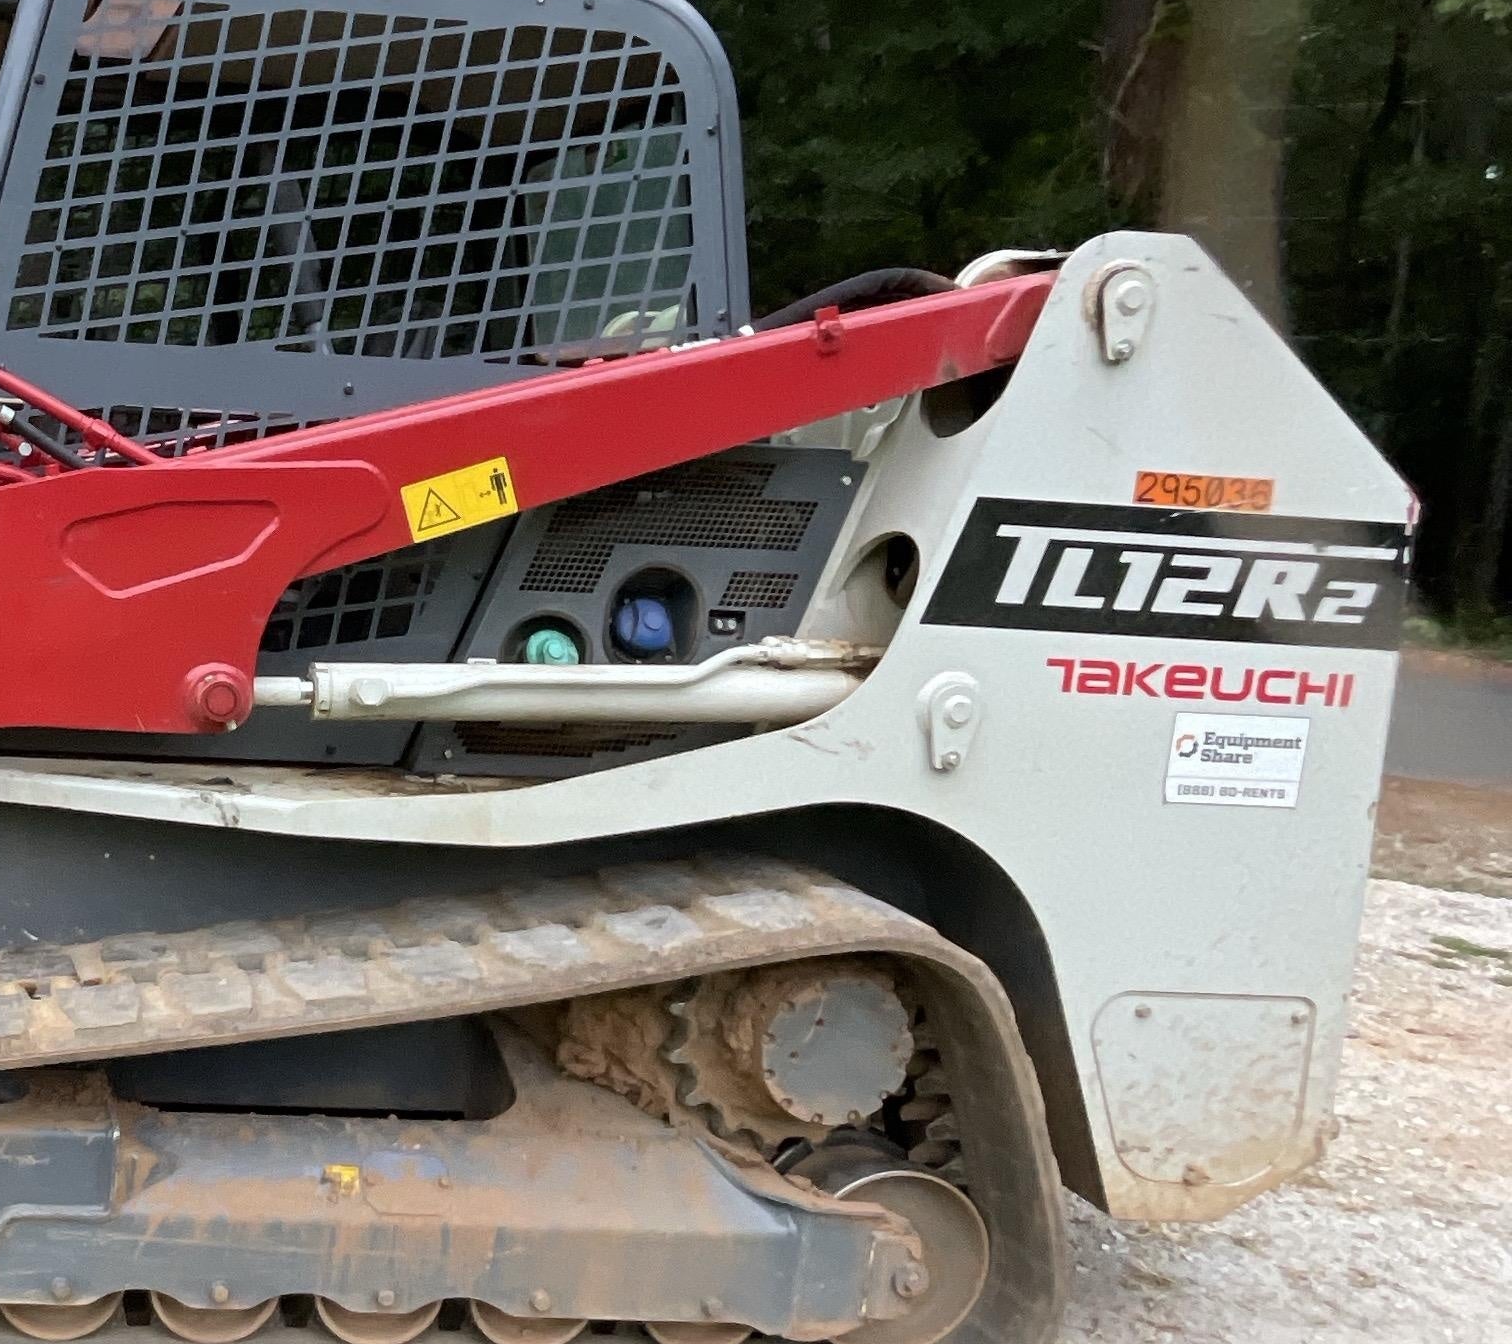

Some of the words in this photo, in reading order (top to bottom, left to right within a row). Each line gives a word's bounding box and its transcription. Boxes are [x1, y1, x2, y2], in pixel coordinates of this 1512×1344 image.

[1045, 658, 1355, 708] TAKEUCHI
[1203, 731, 1303, 751] Equipment
[1200, 748, 1253, 764] Share
